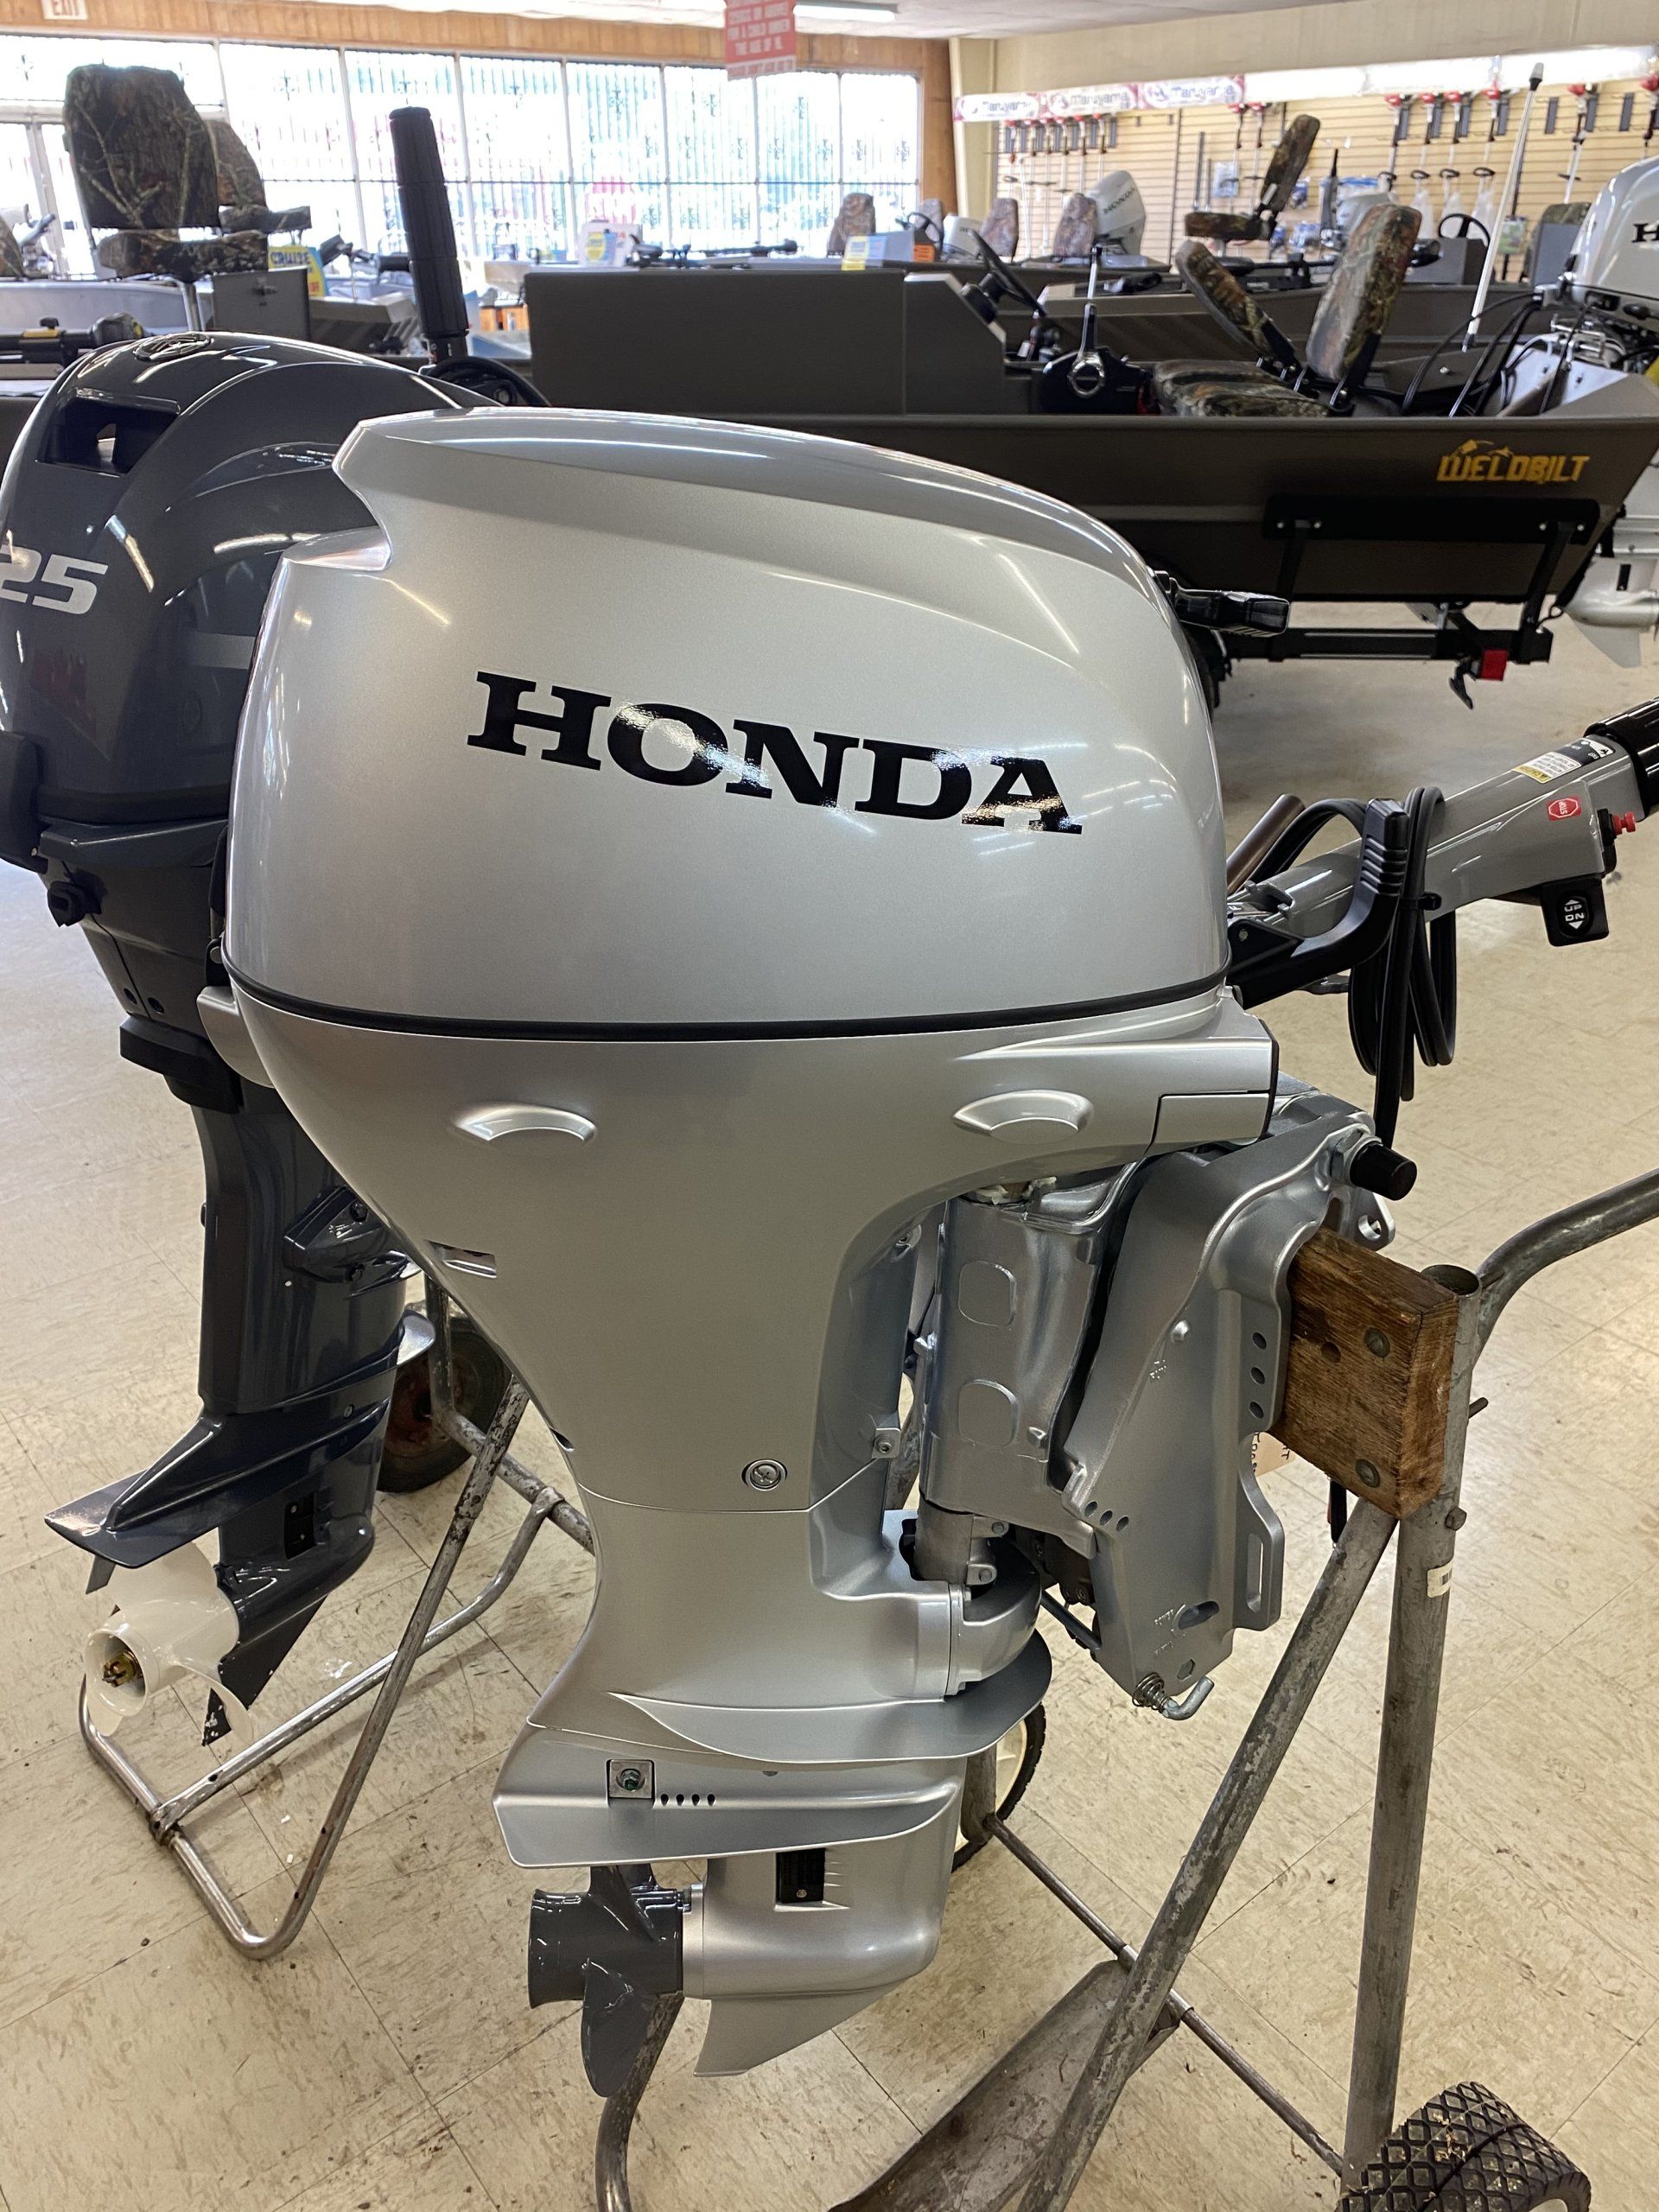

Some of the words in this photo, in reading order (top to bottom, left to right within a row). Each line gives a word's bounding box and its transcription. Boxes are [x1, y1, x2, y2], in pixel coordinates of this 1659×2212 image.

[1436, 454, 1590, 484] WELDBILT
[467, 671, 1083, 835] HONDA
[1564, 904, 1583, 912] UP
[1565, 912, 1585, 922] DN
